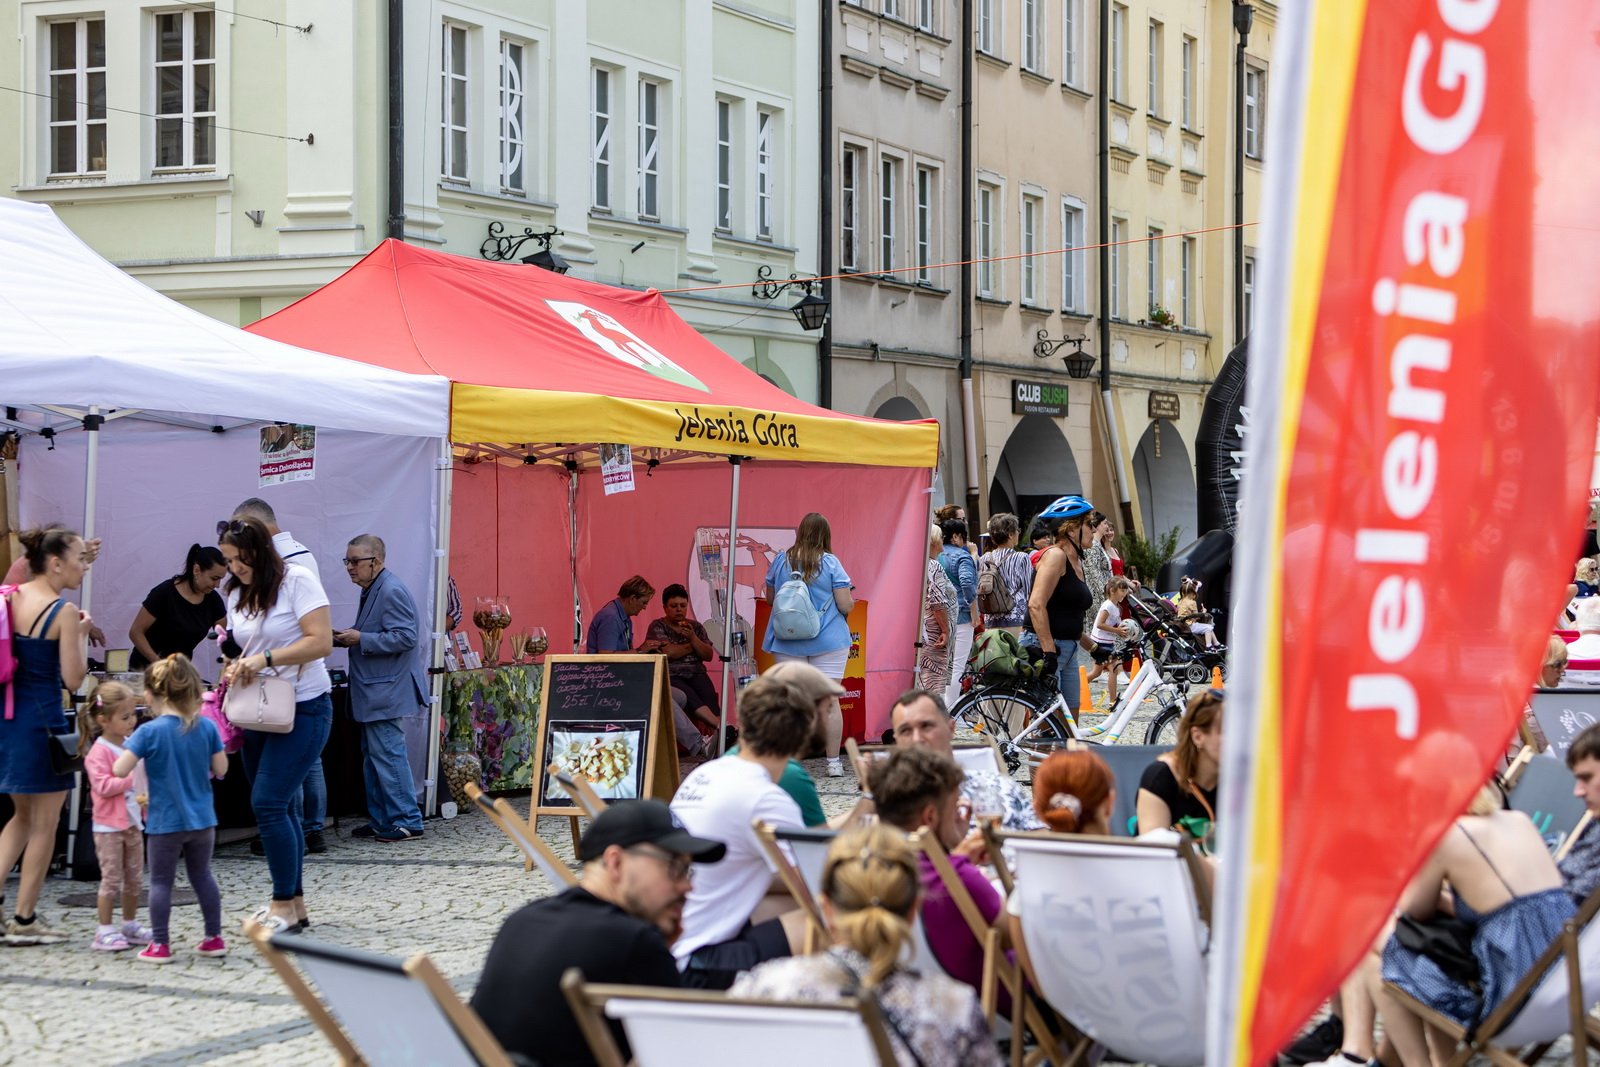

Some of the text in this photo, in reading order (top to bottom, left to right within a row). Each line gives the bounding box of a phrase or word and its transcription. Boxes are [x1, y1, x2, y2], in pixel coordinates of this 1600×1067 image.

[1018, 384, 1067, 405] CLUB SUSHI
[675, 408, 799, 448] Jelenia Góra
[1347, 190, 1470, 740] Jelenia
